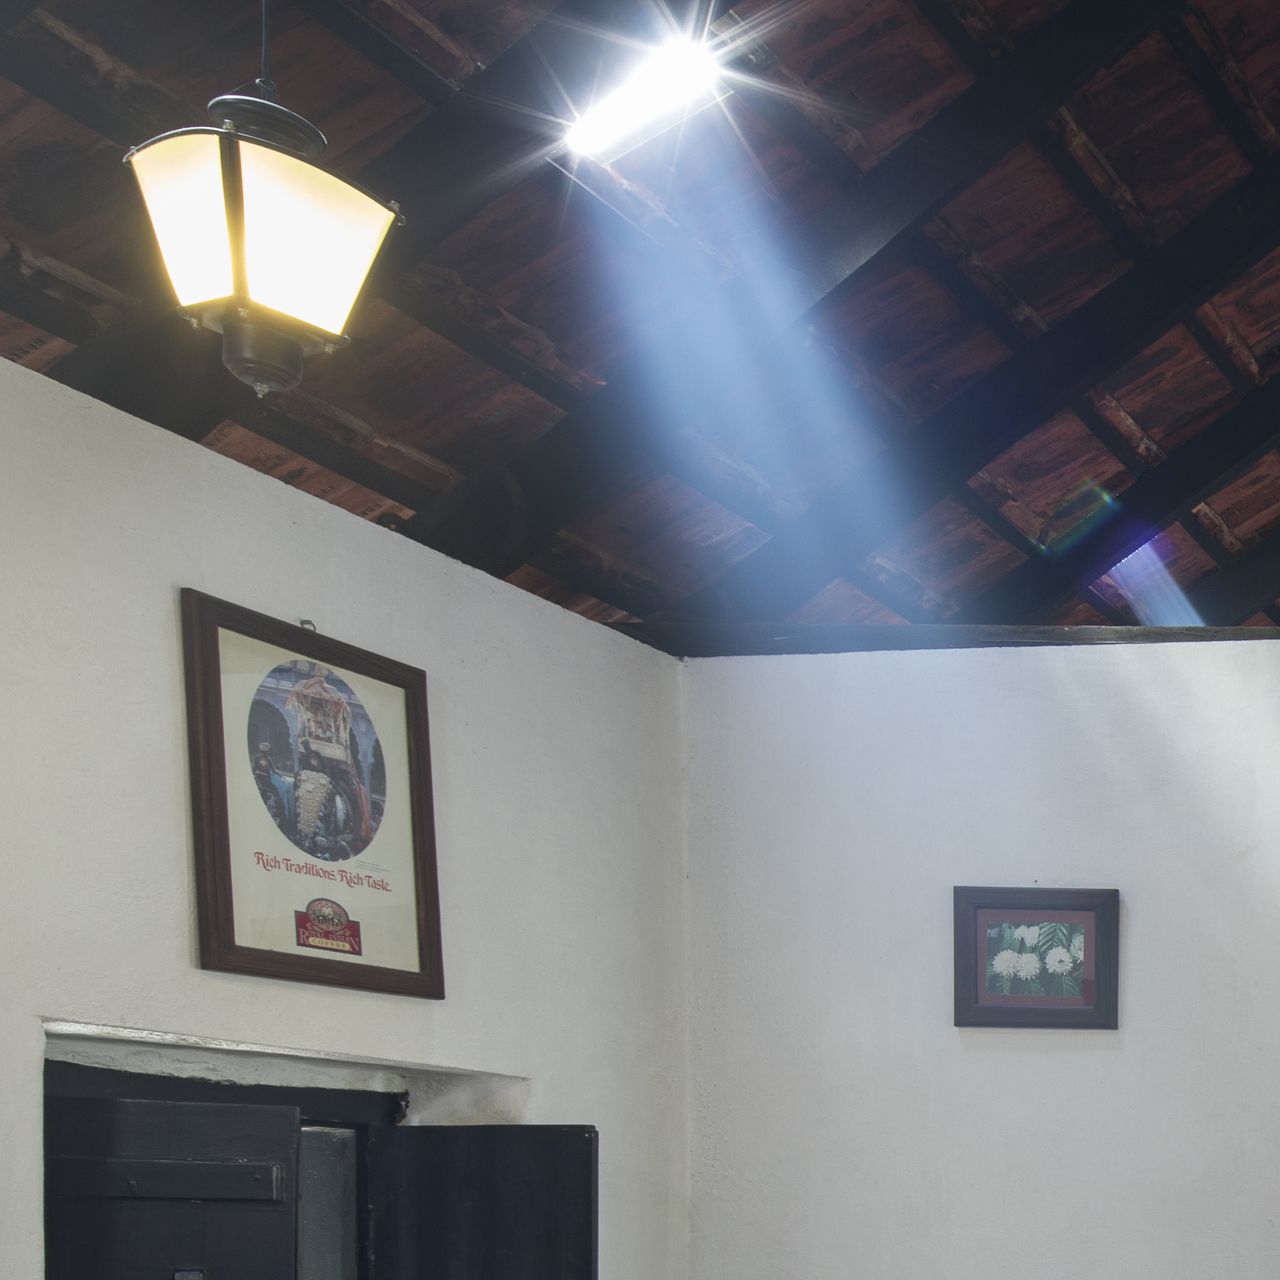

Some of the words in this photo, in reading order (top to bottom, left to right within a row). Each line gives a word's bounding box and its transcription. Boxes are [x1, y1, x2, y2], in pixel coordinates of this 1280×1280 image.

[254, 851, 281, 872] Rich
[338, 869, 364, 888] Rich
[311, 938, 347, 949] COFFEE
